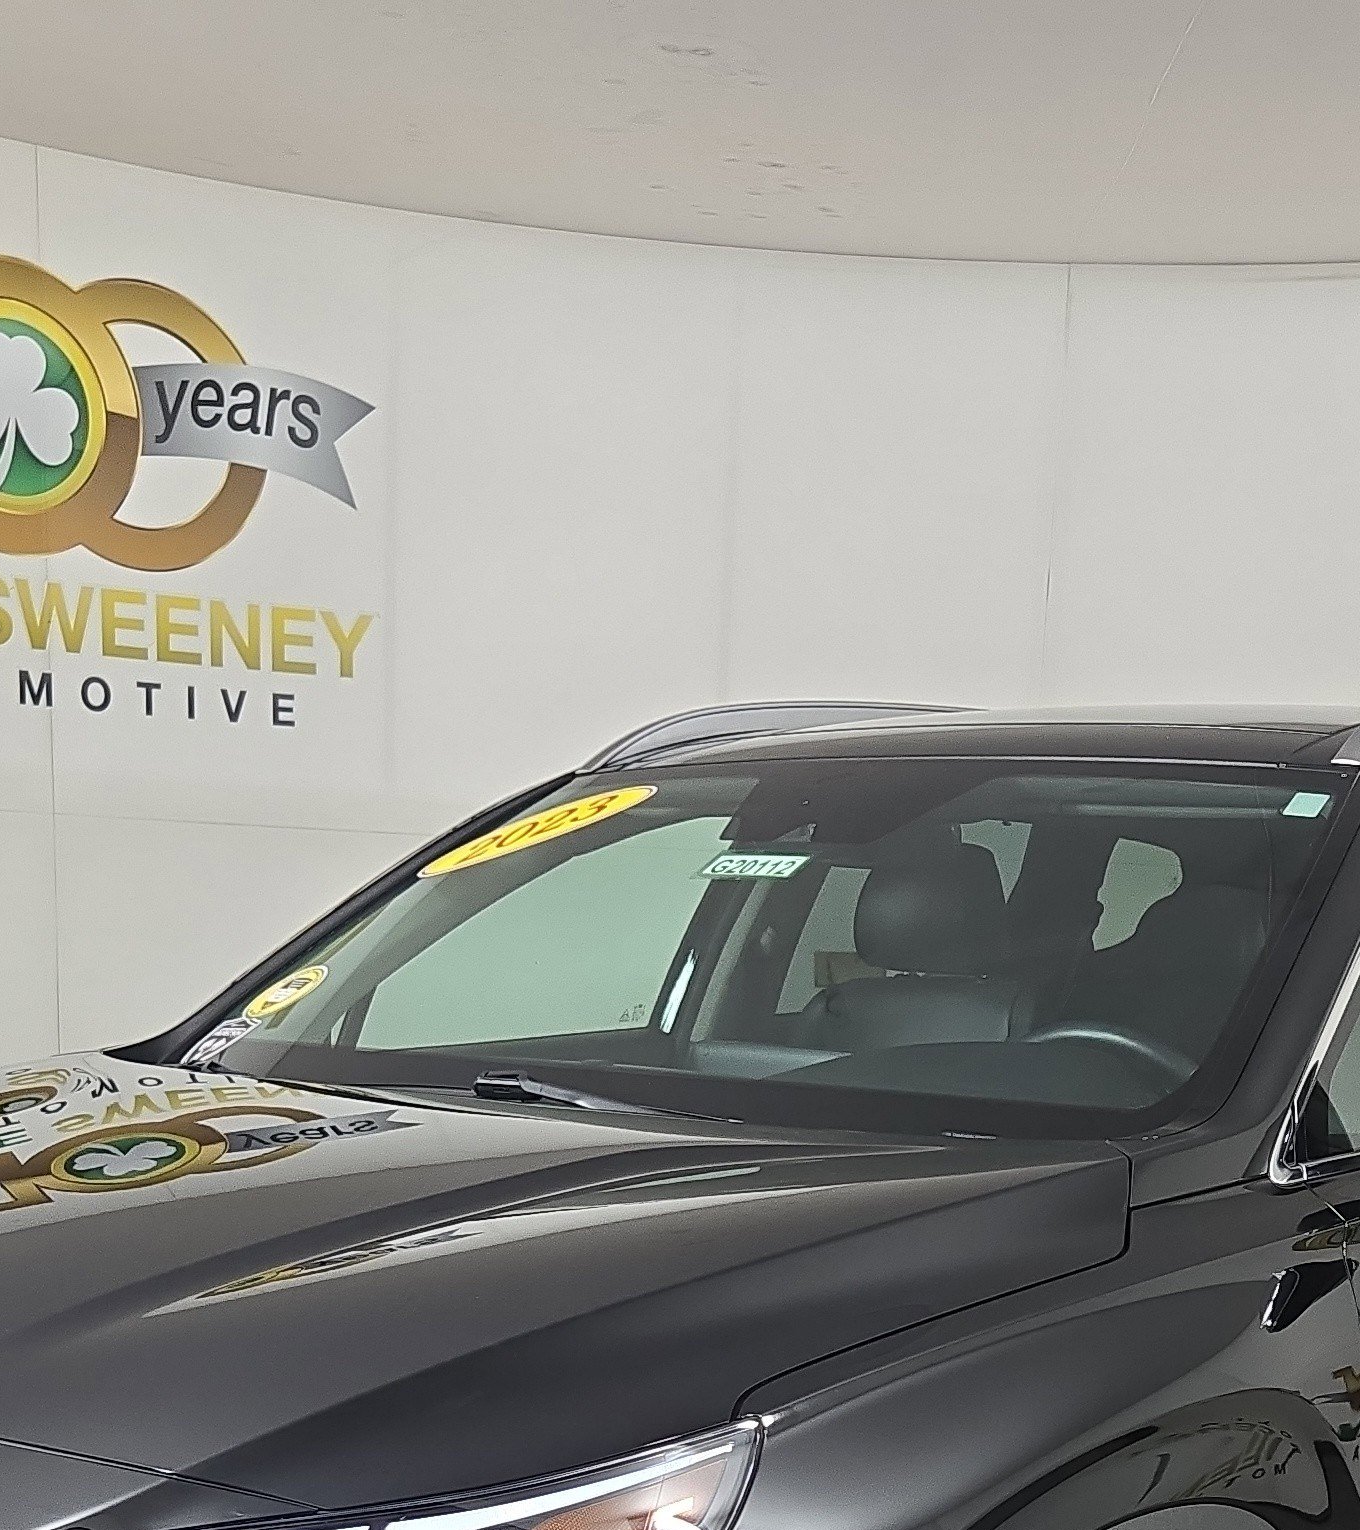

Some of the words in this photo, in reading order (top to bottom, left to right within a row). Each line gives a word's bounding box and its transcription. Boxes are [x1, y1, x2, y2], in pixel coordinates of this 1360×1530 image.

[154, 377, 322, 449] years
[460, 794, 620, 865] 2023
[708, 858, 798, 876] G20112
